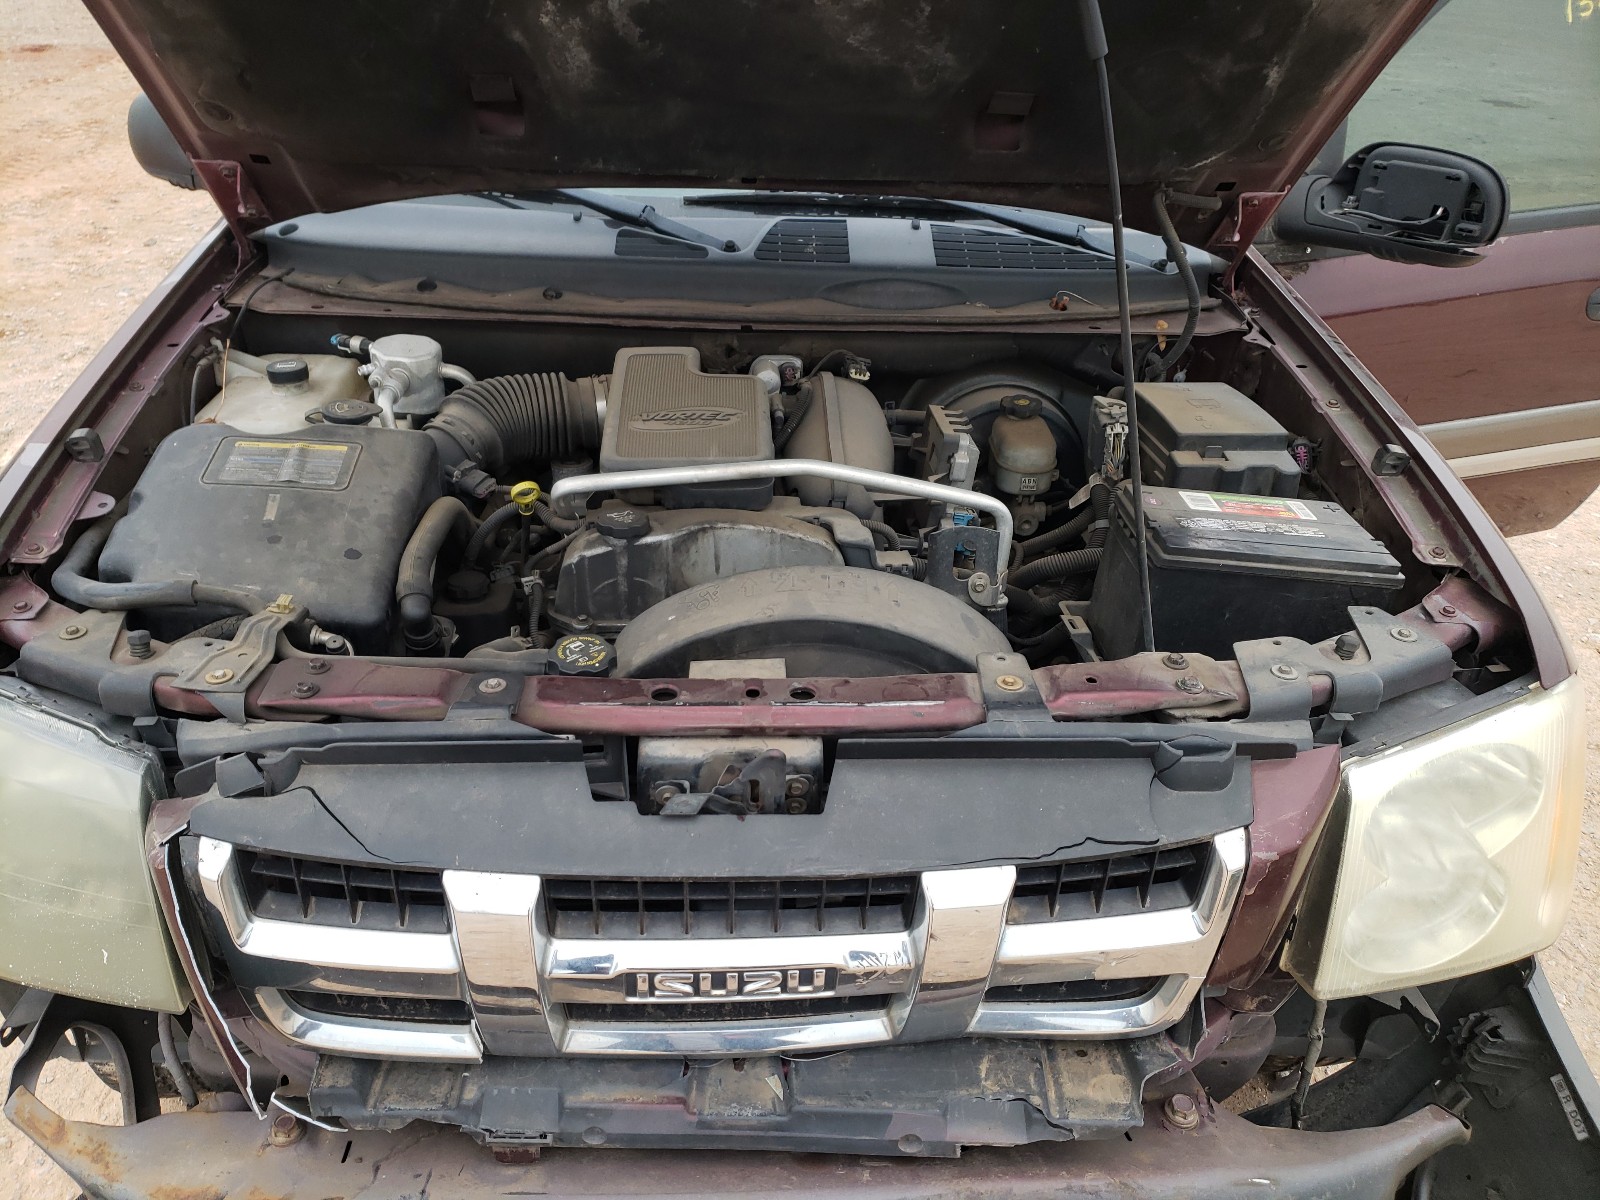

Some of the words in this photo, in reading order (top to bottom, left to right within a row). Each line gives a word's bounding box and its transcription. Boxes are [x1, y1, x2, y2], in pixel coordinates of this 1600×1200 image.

[640, 411, 741, 422] VORTEC
[636, 969, 826, 999] ISUZU
[1568, 1110, 1586, 1133] DOT
